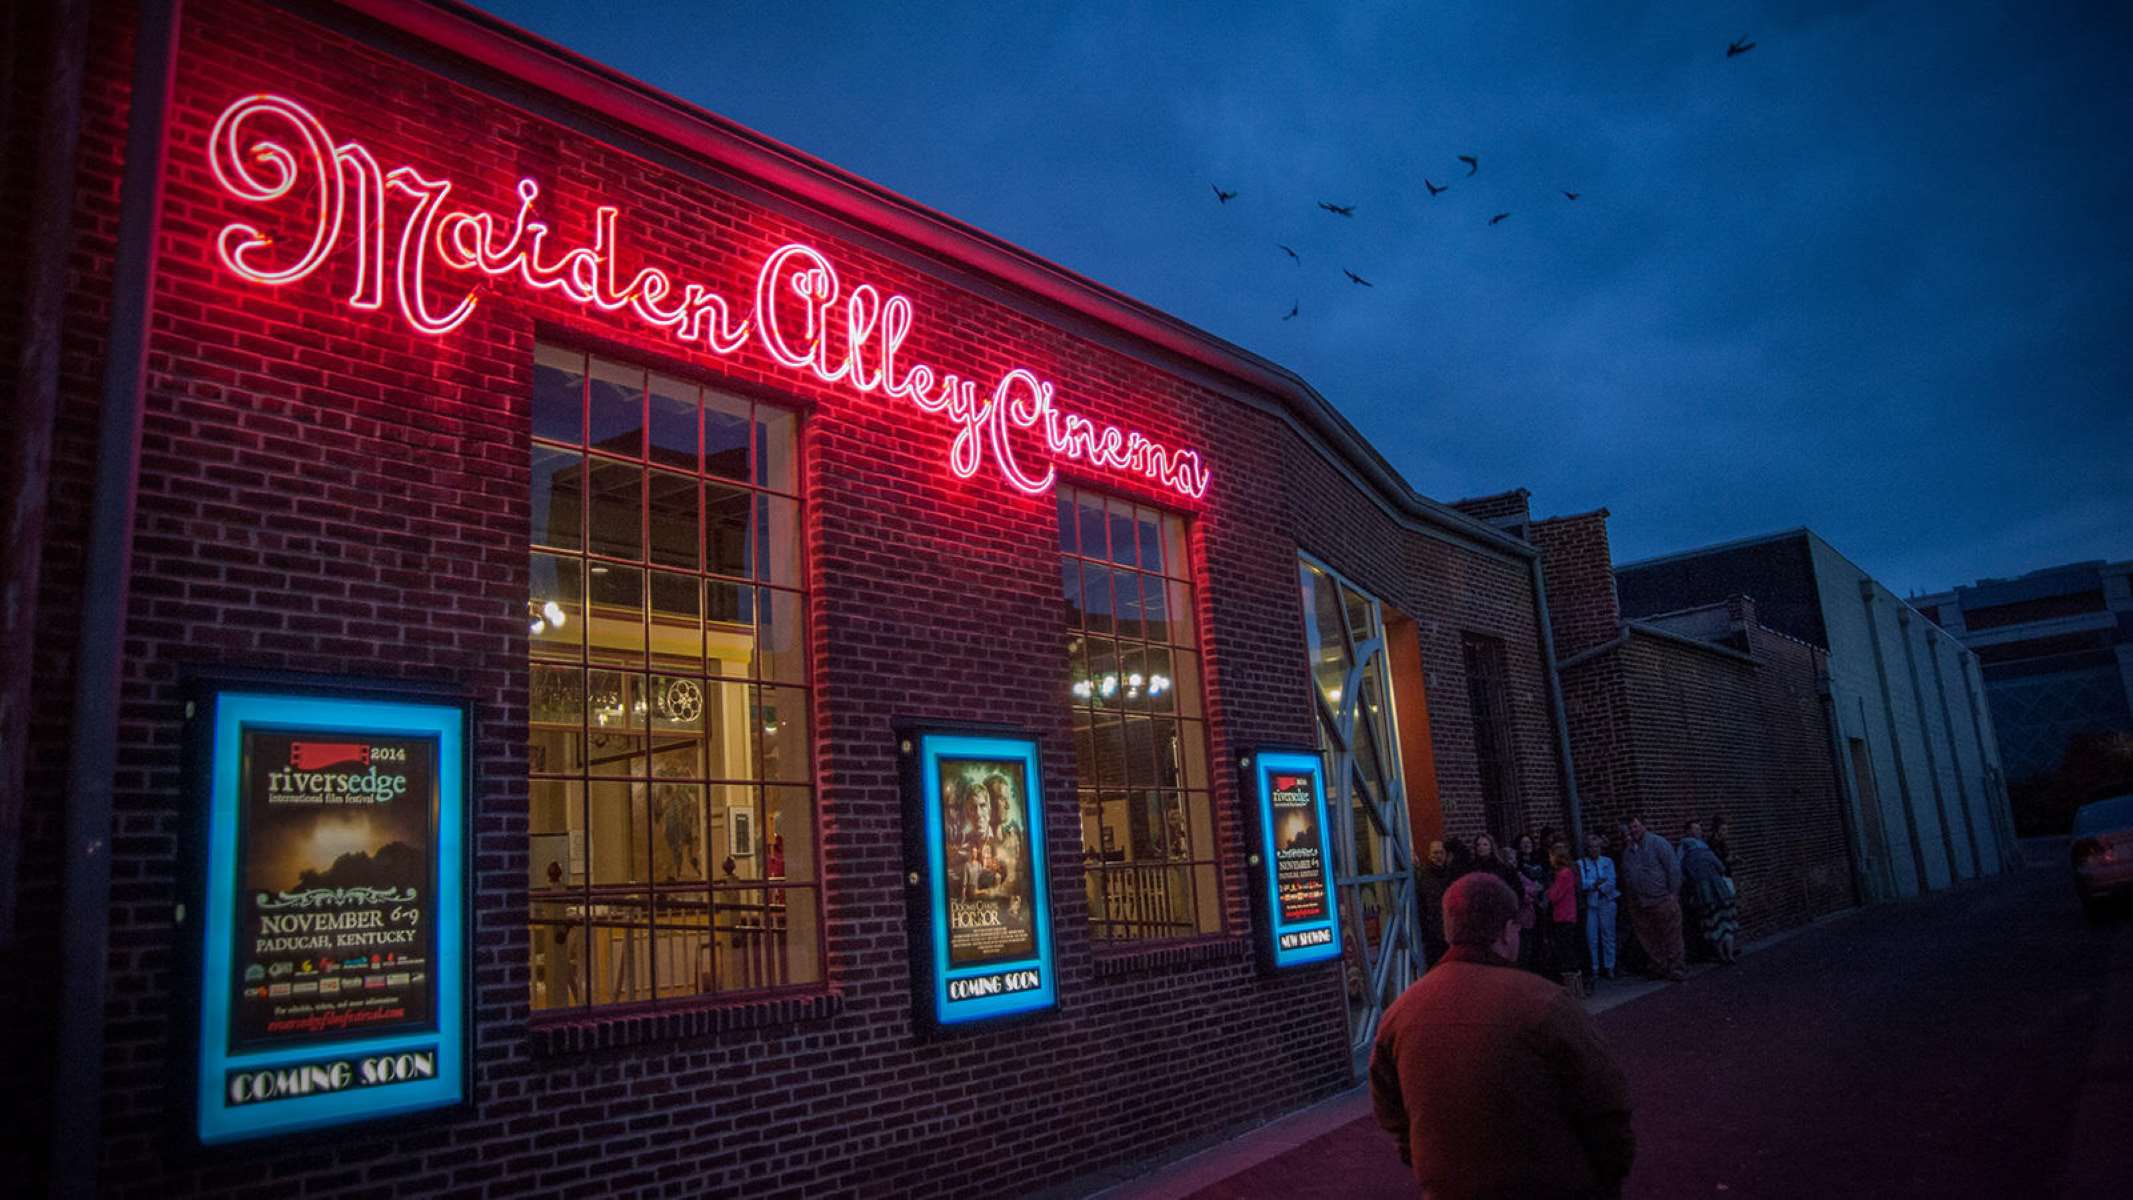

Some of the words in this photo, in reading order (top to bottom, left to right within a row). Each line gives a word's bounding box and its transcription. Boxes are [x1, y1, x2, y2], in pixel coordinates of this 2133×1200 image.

[209, 94, 750, 354] Maiden
[756, 243, 991, 479] Alley
[991, 368, 1212, 499] Cinema
[370, 747, 406, 761] 2014
[268, 765, 407, 802] riversedge
[260, 909, 385, 934] NOVEMBER
[390, 905, 419, 926] 6-9
[952, 910, 1001, 929] HORROR
[255, 934, 333, 954] PADUCAH,
[336, 929, 416, 947] KENTUCKY
[950, 975, 1001, 999] COMING
[1005, 970, 1039, 992] SOON
[230, 1061, 351, 1104] COMING
[361, 1052, 434, 1085] SOON
